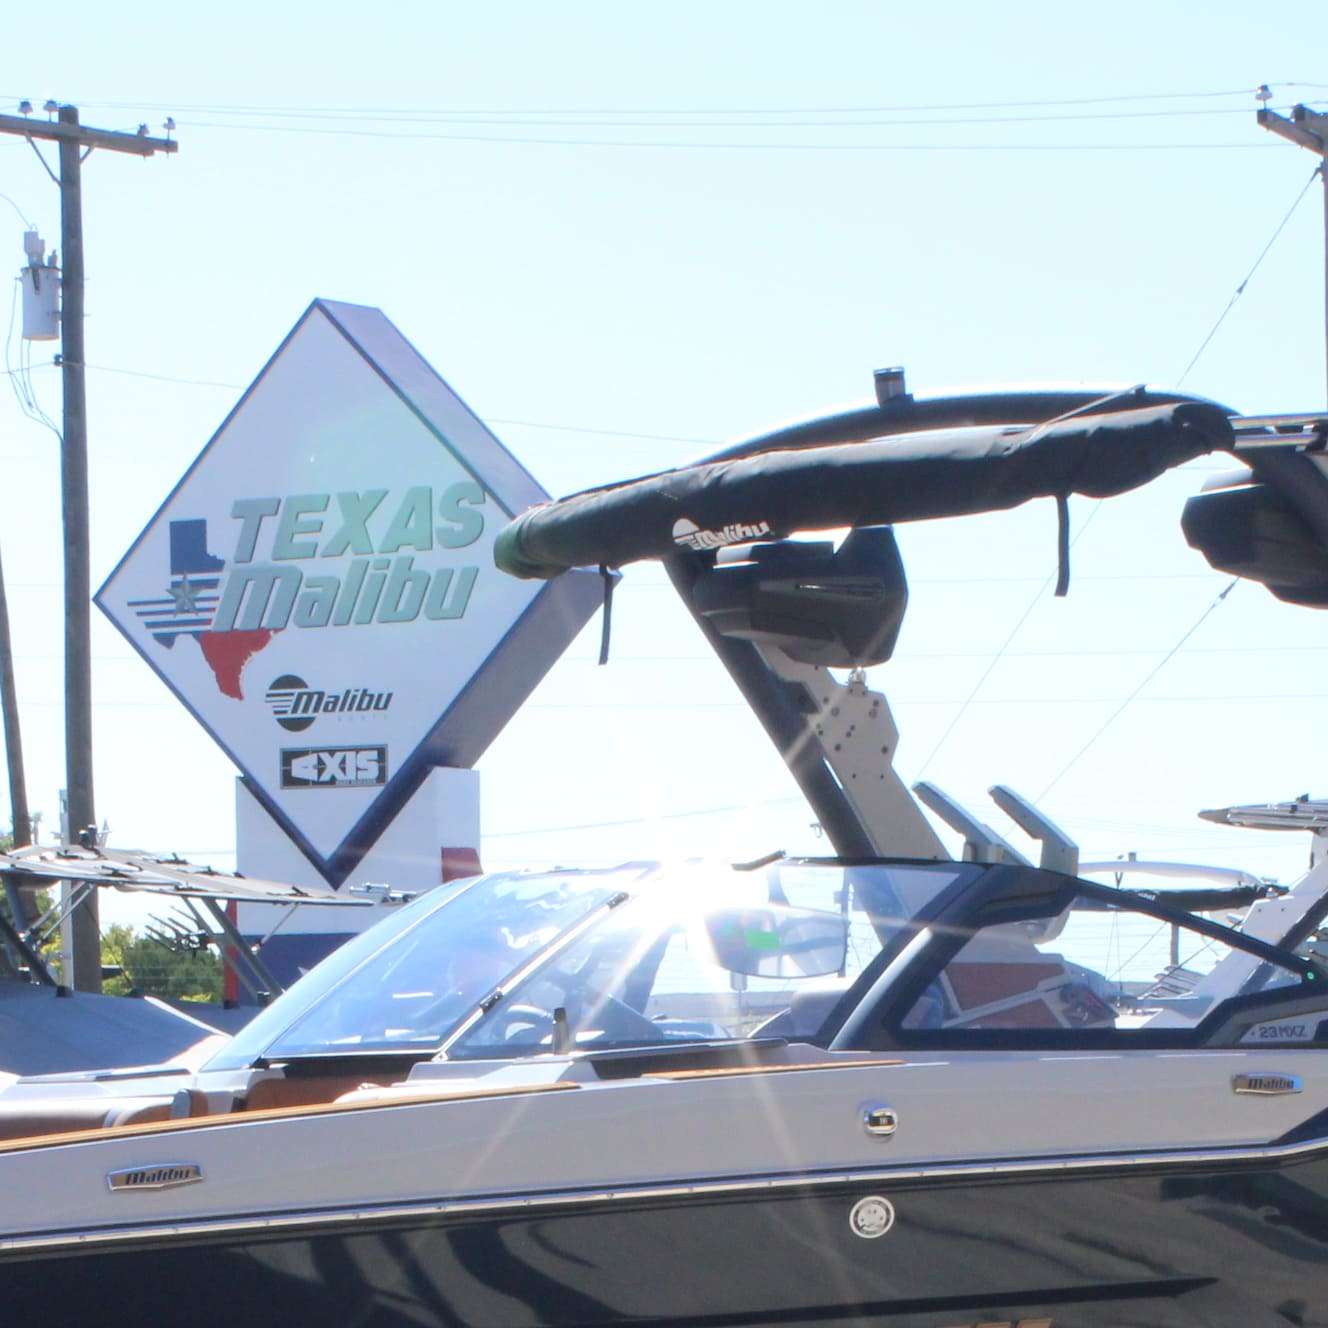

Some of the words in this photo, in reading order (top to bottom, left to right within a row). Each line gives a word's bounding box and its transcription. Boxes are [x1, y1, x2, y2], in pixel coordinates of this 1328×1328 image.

[230, 481, 486, 563] TEXAS
[212, 555, 479, 632] Malibu
[291, 688, 393, 714] Malibu
[291, 749, 380, 782] AXIS
